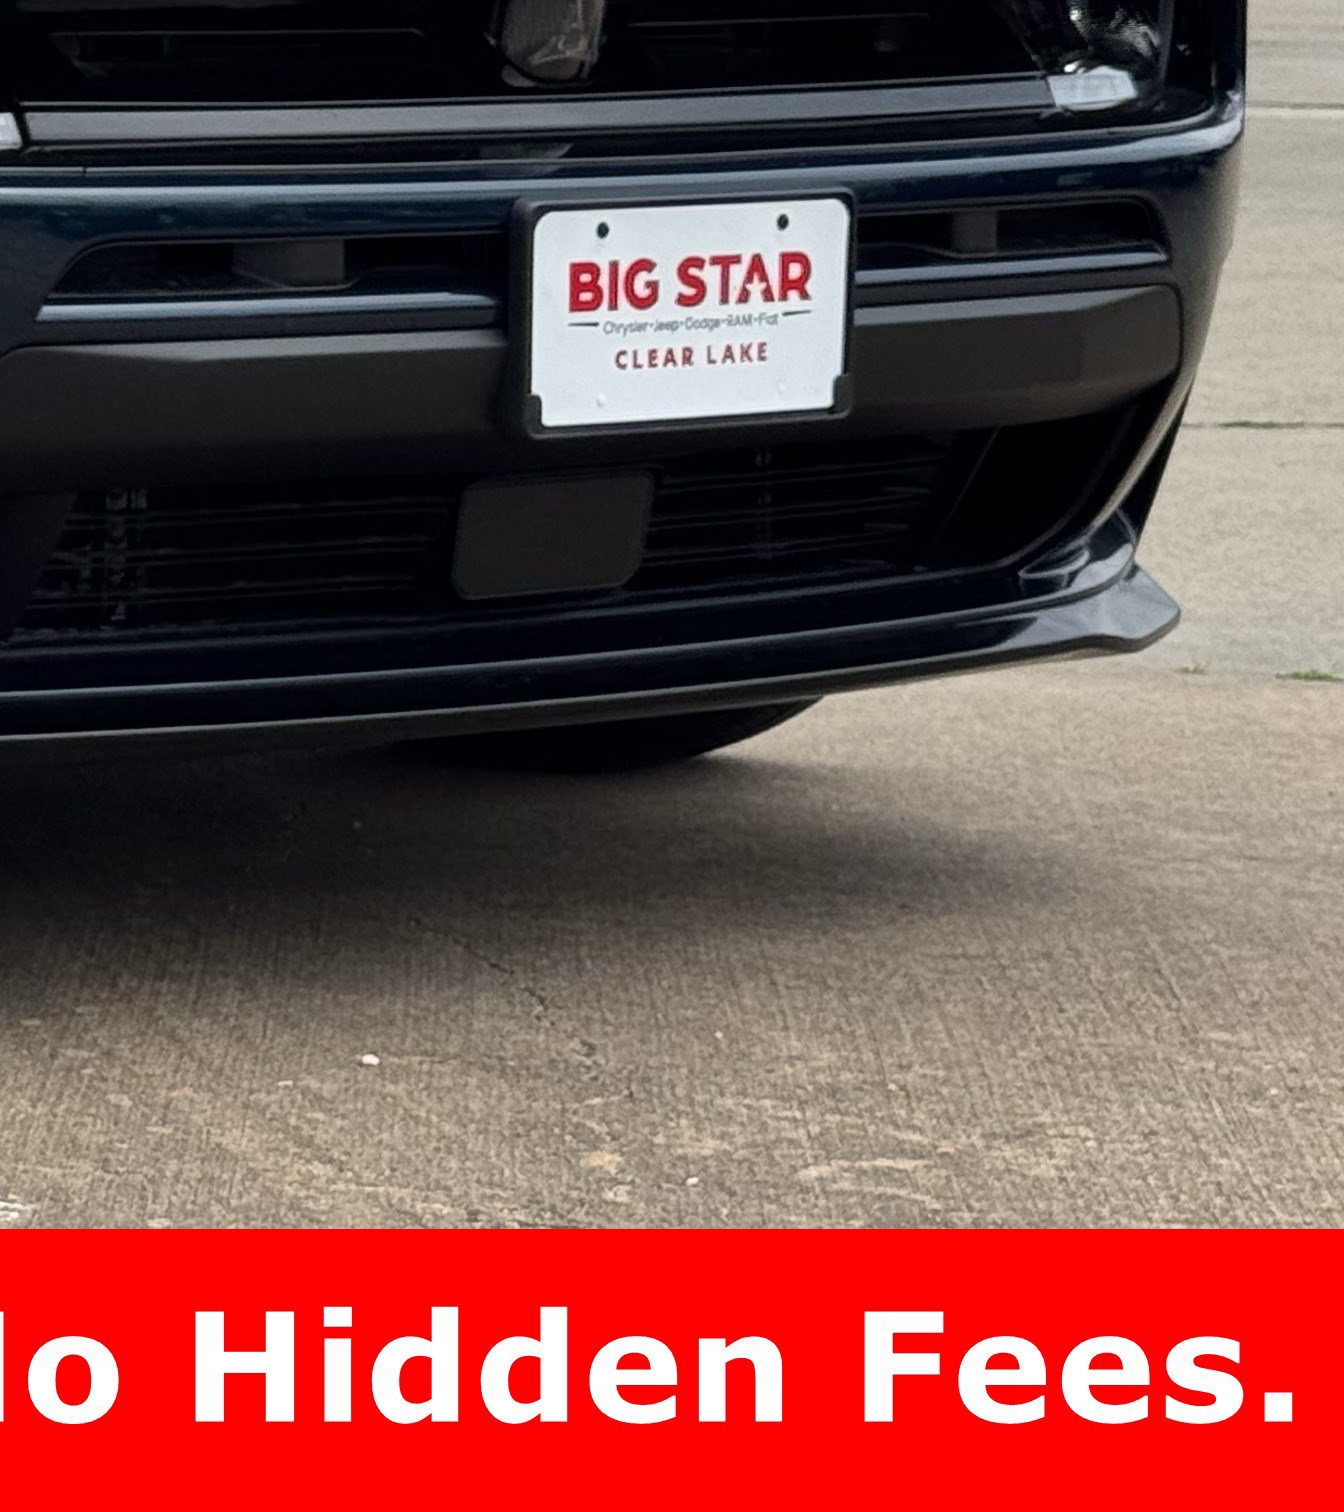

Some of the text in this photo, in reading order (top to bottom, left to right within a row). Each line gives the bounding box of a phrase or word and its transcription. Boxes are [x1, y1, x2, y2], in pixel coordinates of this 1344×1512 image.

[568, 250, 812, 314] BIG STAR
[614, 341, 769, 371] CLEAR LAKE
